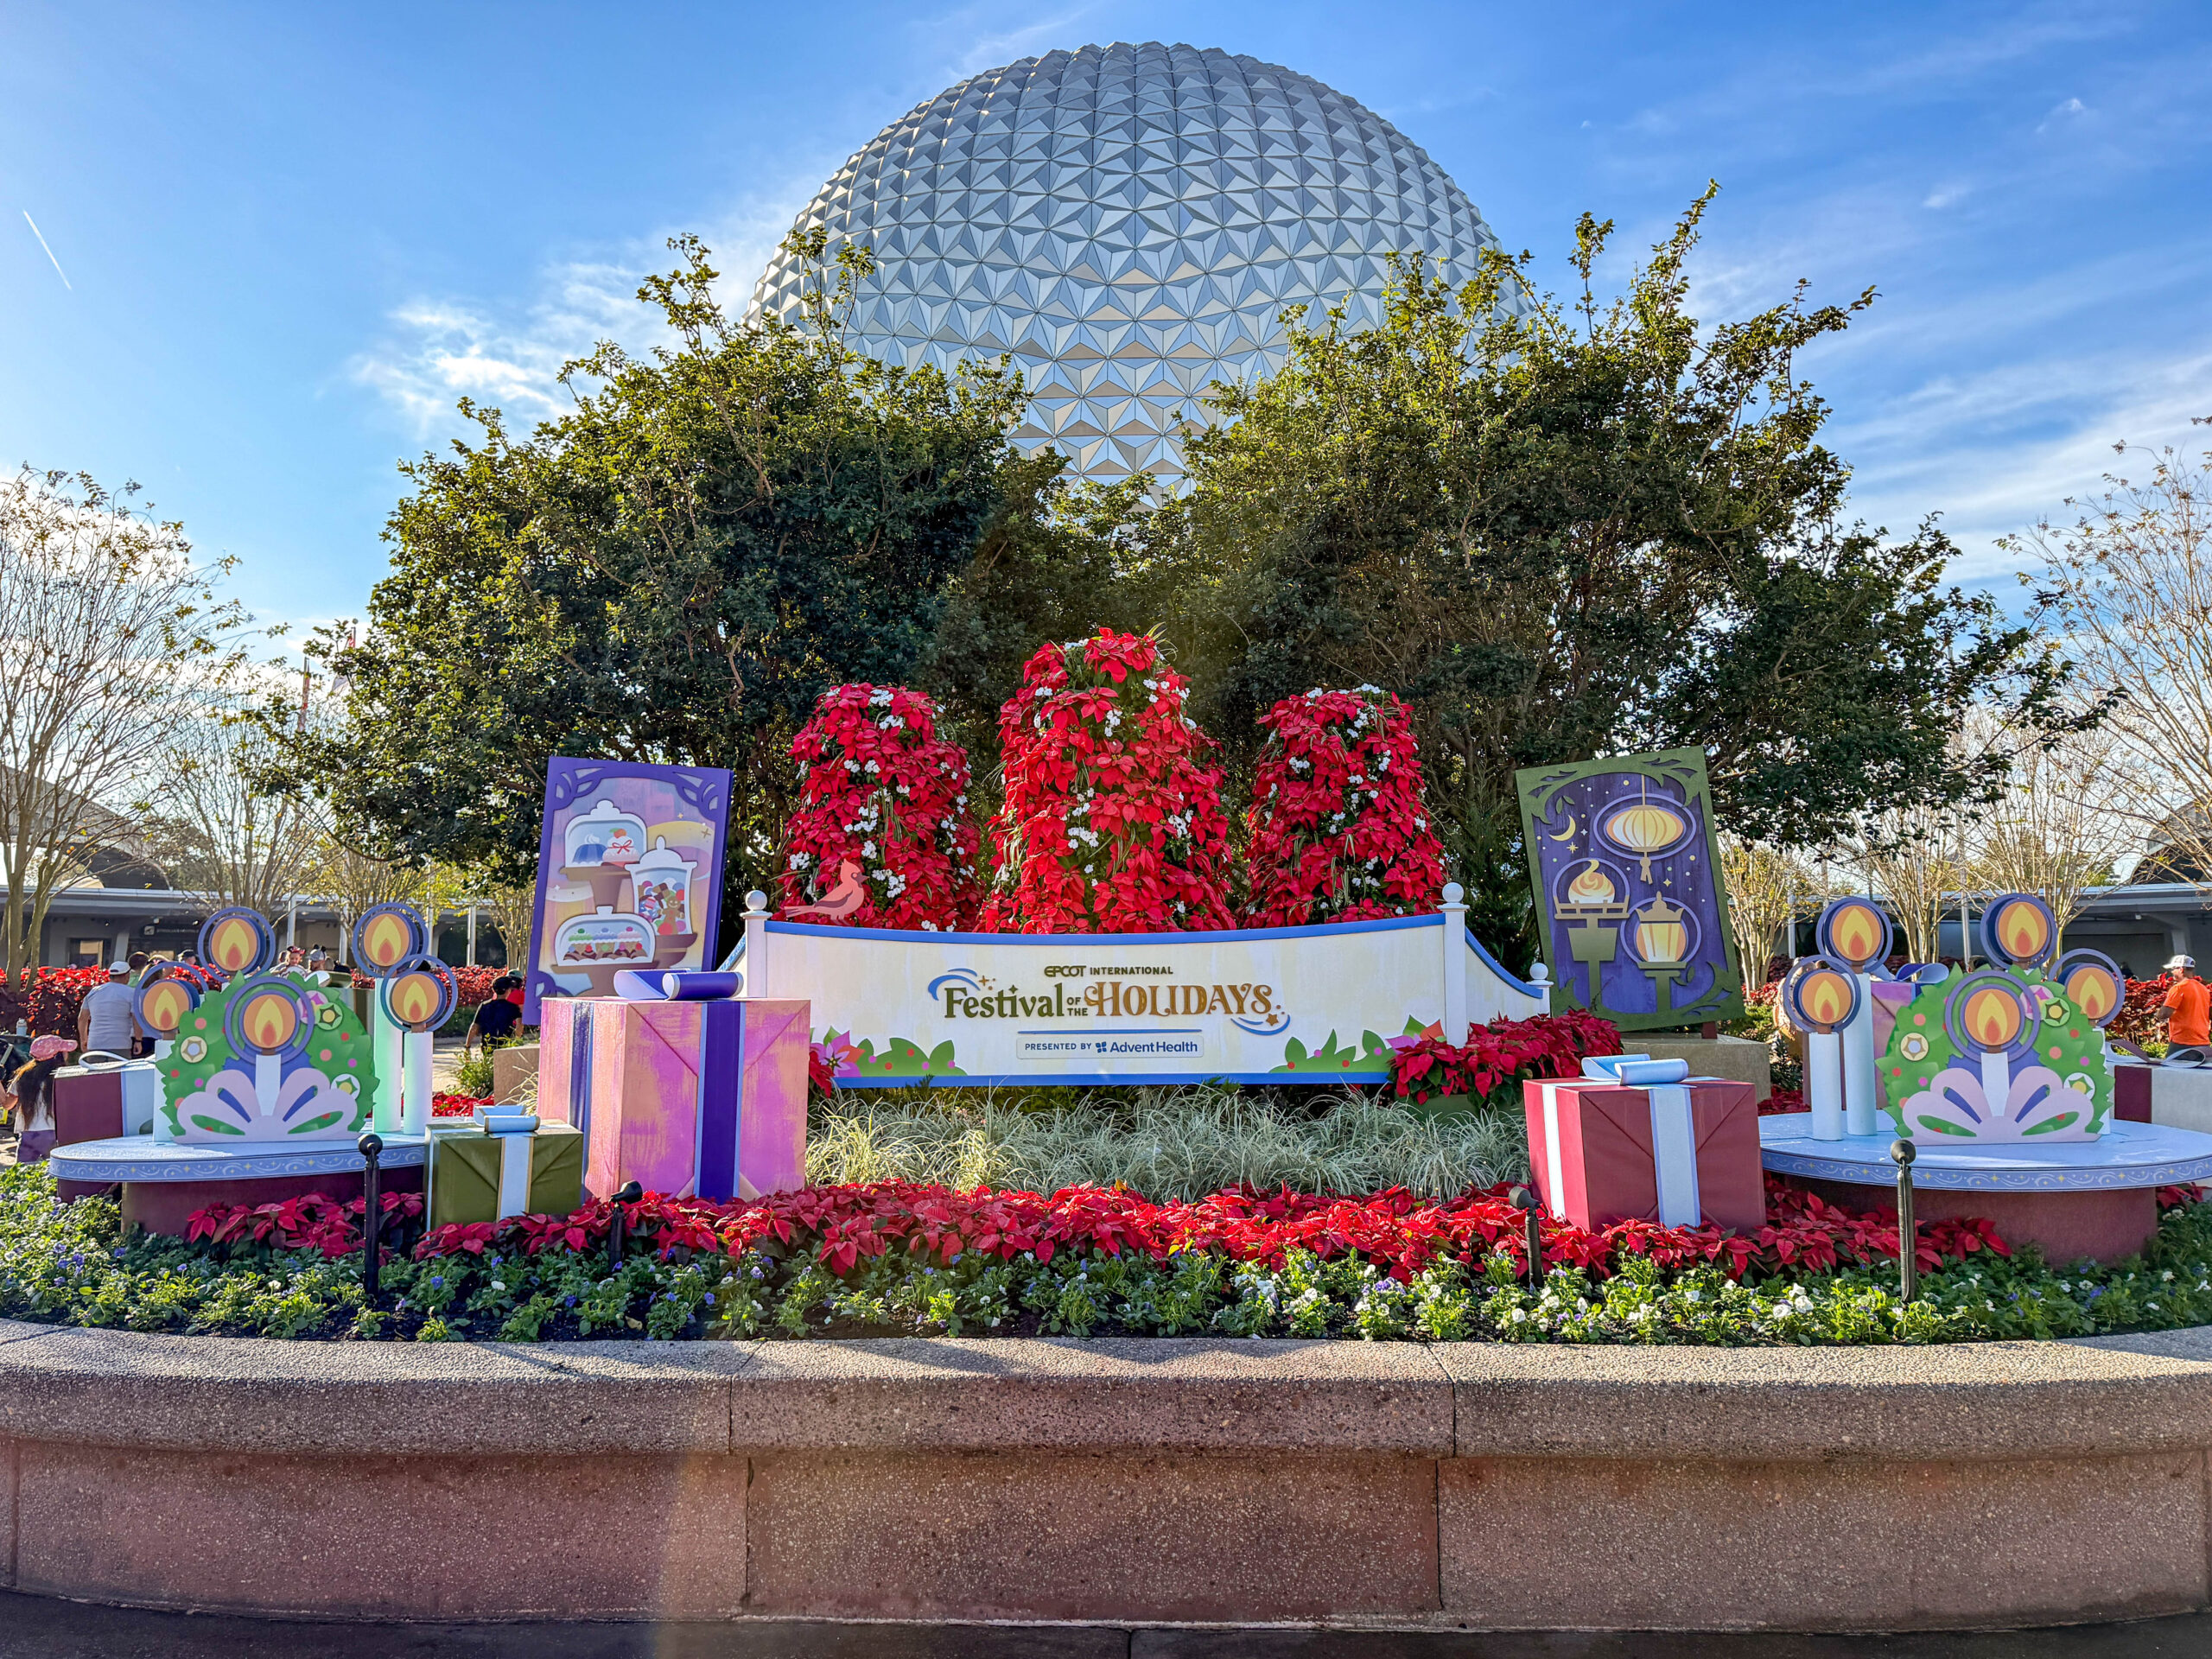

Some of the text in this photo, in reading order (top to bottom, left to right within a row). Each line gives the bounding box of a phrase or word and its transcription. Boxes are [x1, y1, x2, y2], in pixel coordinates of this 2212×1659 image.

[1044, 965, 1173, 977] EPCOT INTERNATIONAL
[944, 982, 1273, 1019] Festival OF THE HOLIDAYS
[1025, 1042, 1077, 1051] PRESENTED
[1109, 1041, 1198, 1053] AdventHealth
